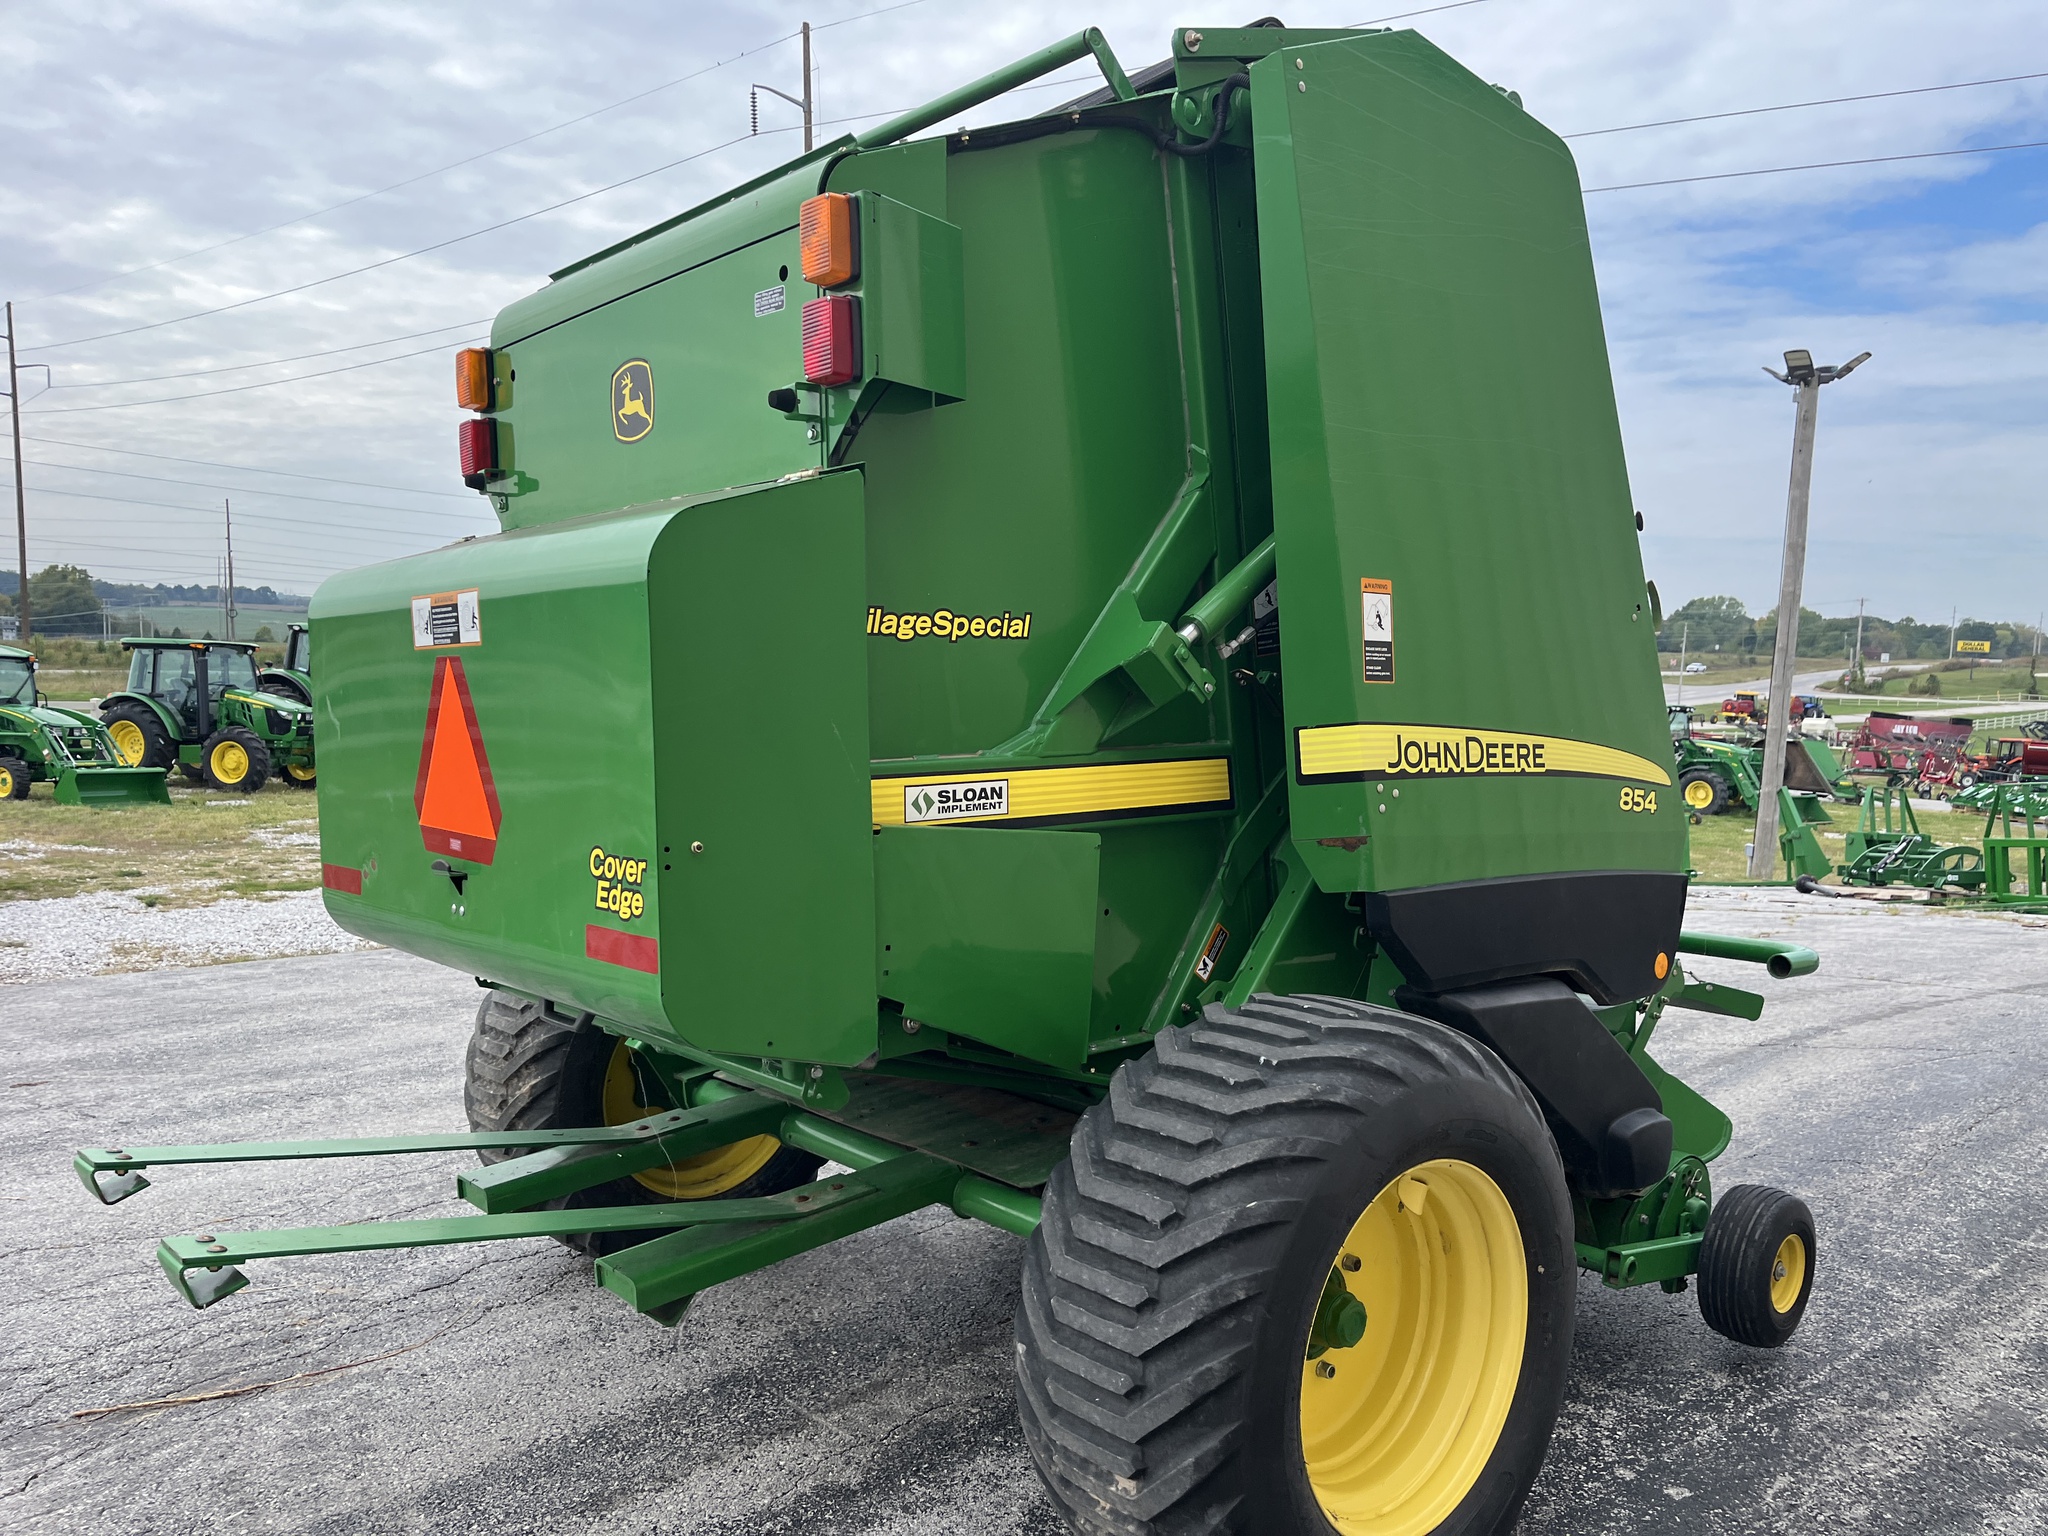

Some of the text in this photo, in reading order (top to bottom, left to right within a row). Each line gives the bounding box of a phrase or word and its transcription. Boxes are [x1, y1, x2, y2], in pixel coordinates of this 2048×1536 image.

[867, 606, 1032, 643] ilageSpecial
[1387, 734, 1546, 771] JOHN DEERE
[937, 786, 1003, 804] SLOAN
[937, 801, 1003, 814] IMPLEMENT
[1619, 786, 1657, 814] 854
[589, 846, 647, 885] Cover
[595, 879, 644, 921] Edge
